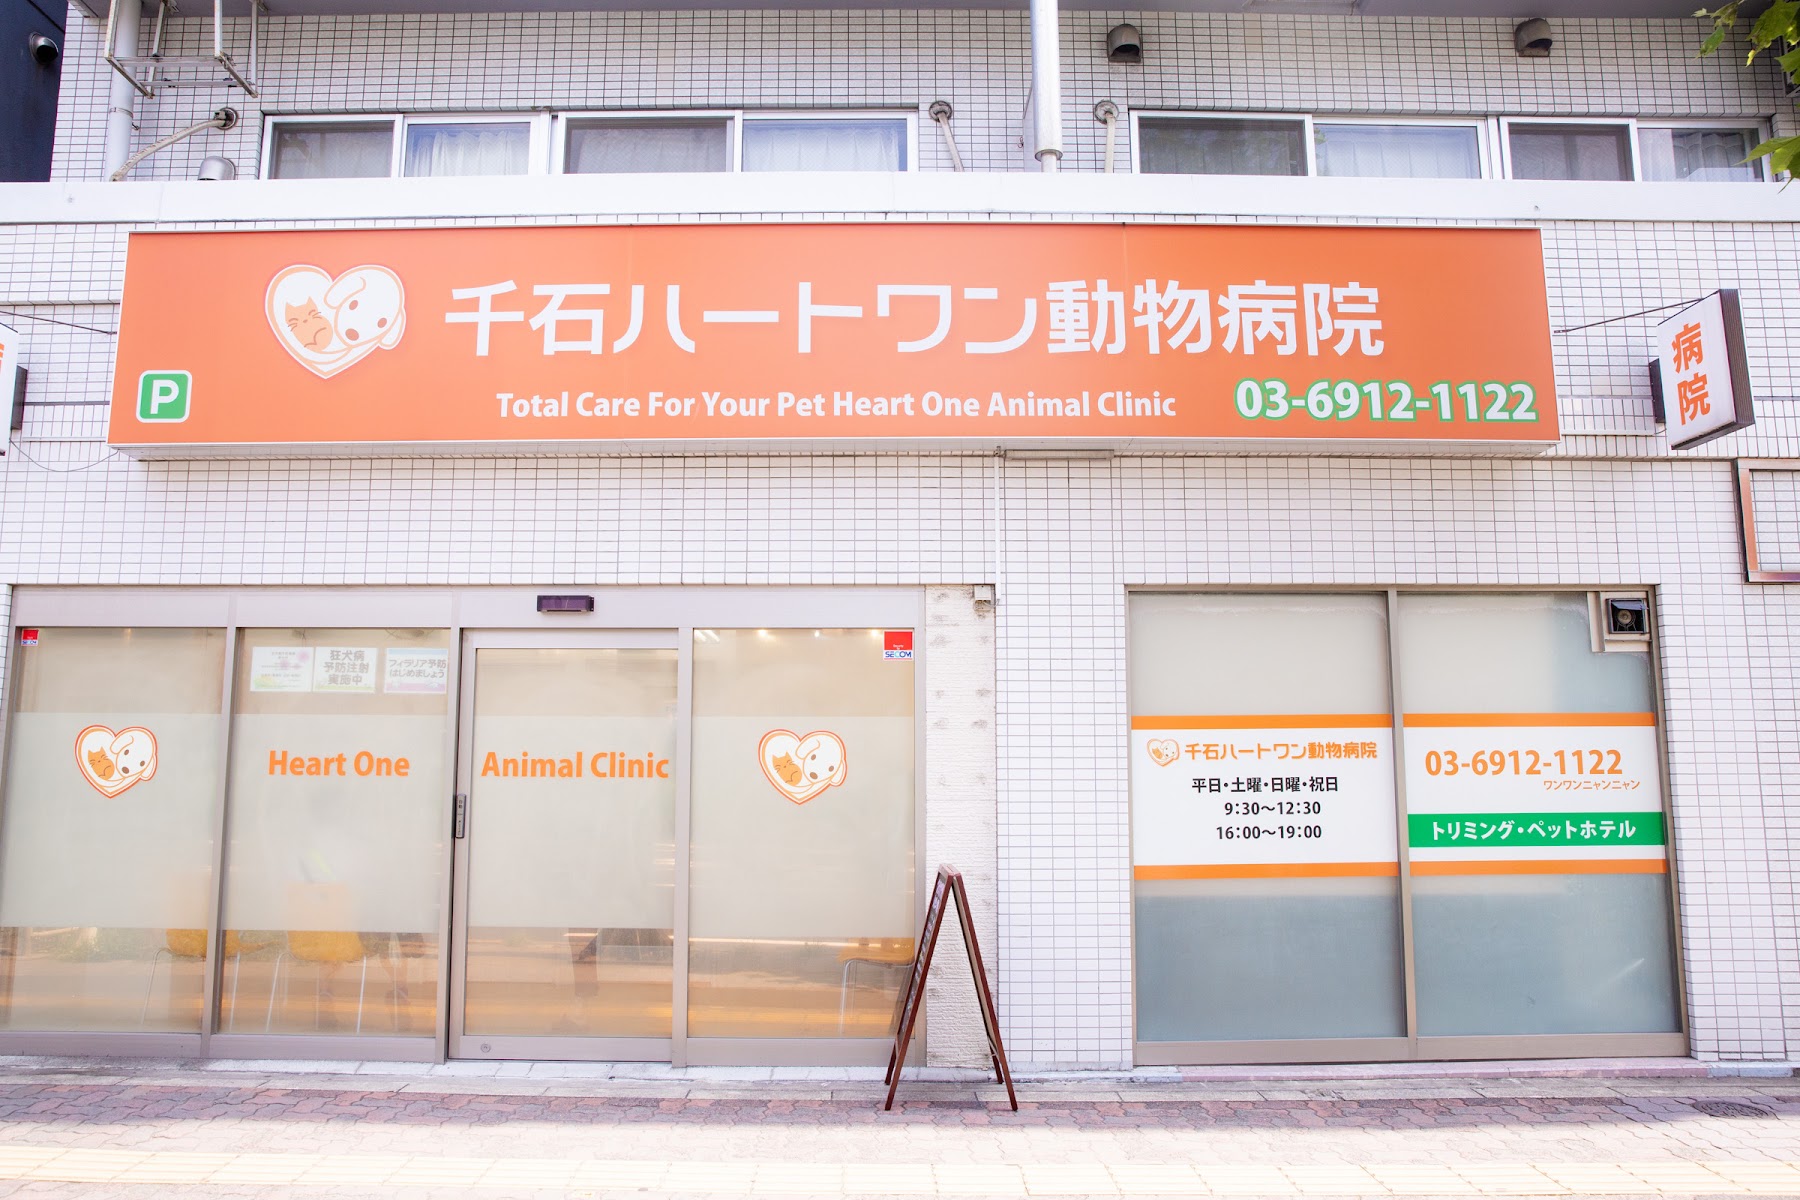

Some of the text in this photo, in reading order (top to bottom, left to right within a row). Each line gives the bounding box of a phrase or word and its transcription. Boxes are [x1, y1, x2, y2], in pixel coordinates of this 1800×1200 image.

[445, 279, 1384, 356] 千石ハートワン動物病院
[1672, 322, 1711, 425] 病院
[150, 379, 179, 414] P
[496, 391, 1175, 417] Total Care For Your Pet Heart One Animal Clinic
[1236, 380, 1536, 420] 03-6912-1122
[330, 650, 365, 661] 狂犬病
[389, 659, 447, 669] フィラリア予防
[324, 662, 369, 673] 予防注射
[390, 669, 445, 679] はじめましょう
[1185, 742, 1377, 760] 千石ハートワン動物病院
[268, 750, 411, 777] Heart One
[481, 751, 669, 779] Animal Clinic
[1425, 750, 1623, 776] 03-6912-1122
[1192, 776, 1338, 793] 平日・土曜・日曜・祝日
[1543, 780, 1640, 790] ワンワンニャンニャン
[1432, 820, 1636, 840] トリミング・ペットホテル
